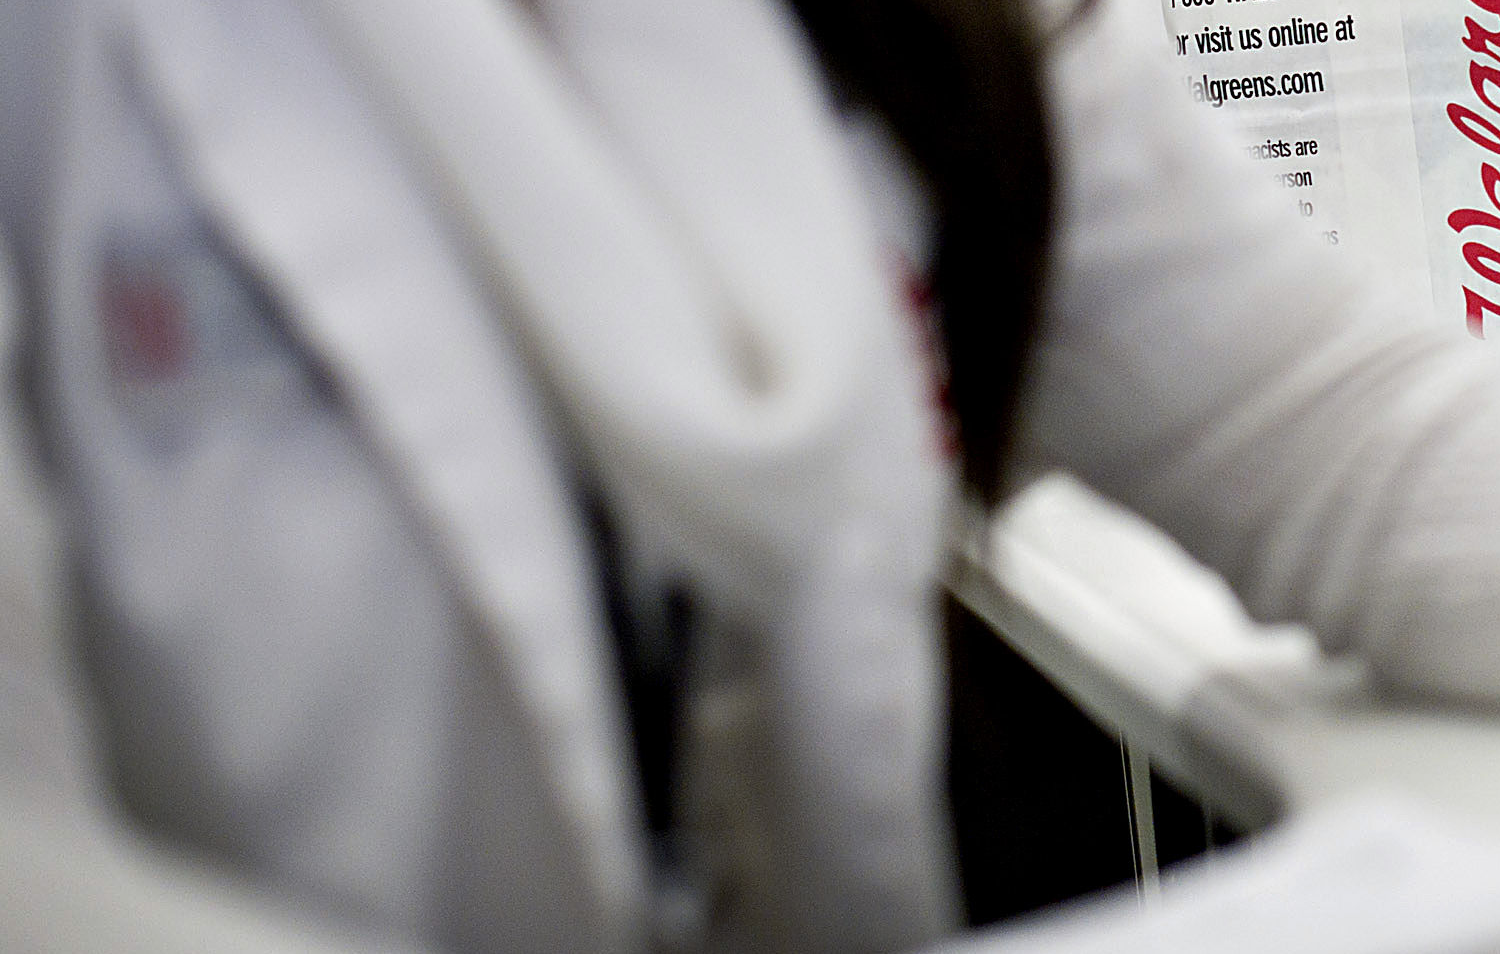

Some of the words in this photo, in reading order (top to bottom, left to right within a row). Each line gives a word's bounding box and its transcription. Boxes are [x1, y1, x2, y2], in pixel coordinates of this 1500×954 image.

[1195, 25, 1234, 54] visit
[1238, 27, 1263, 50] us
[1268, 17, 1329, 48] online
[1335, 14, 1356, 41] at
[1187, 70, 1324, 108] algreens.com
[1247, 139, 1292, 161] acists
[1295, 139, 1318, 157] are
